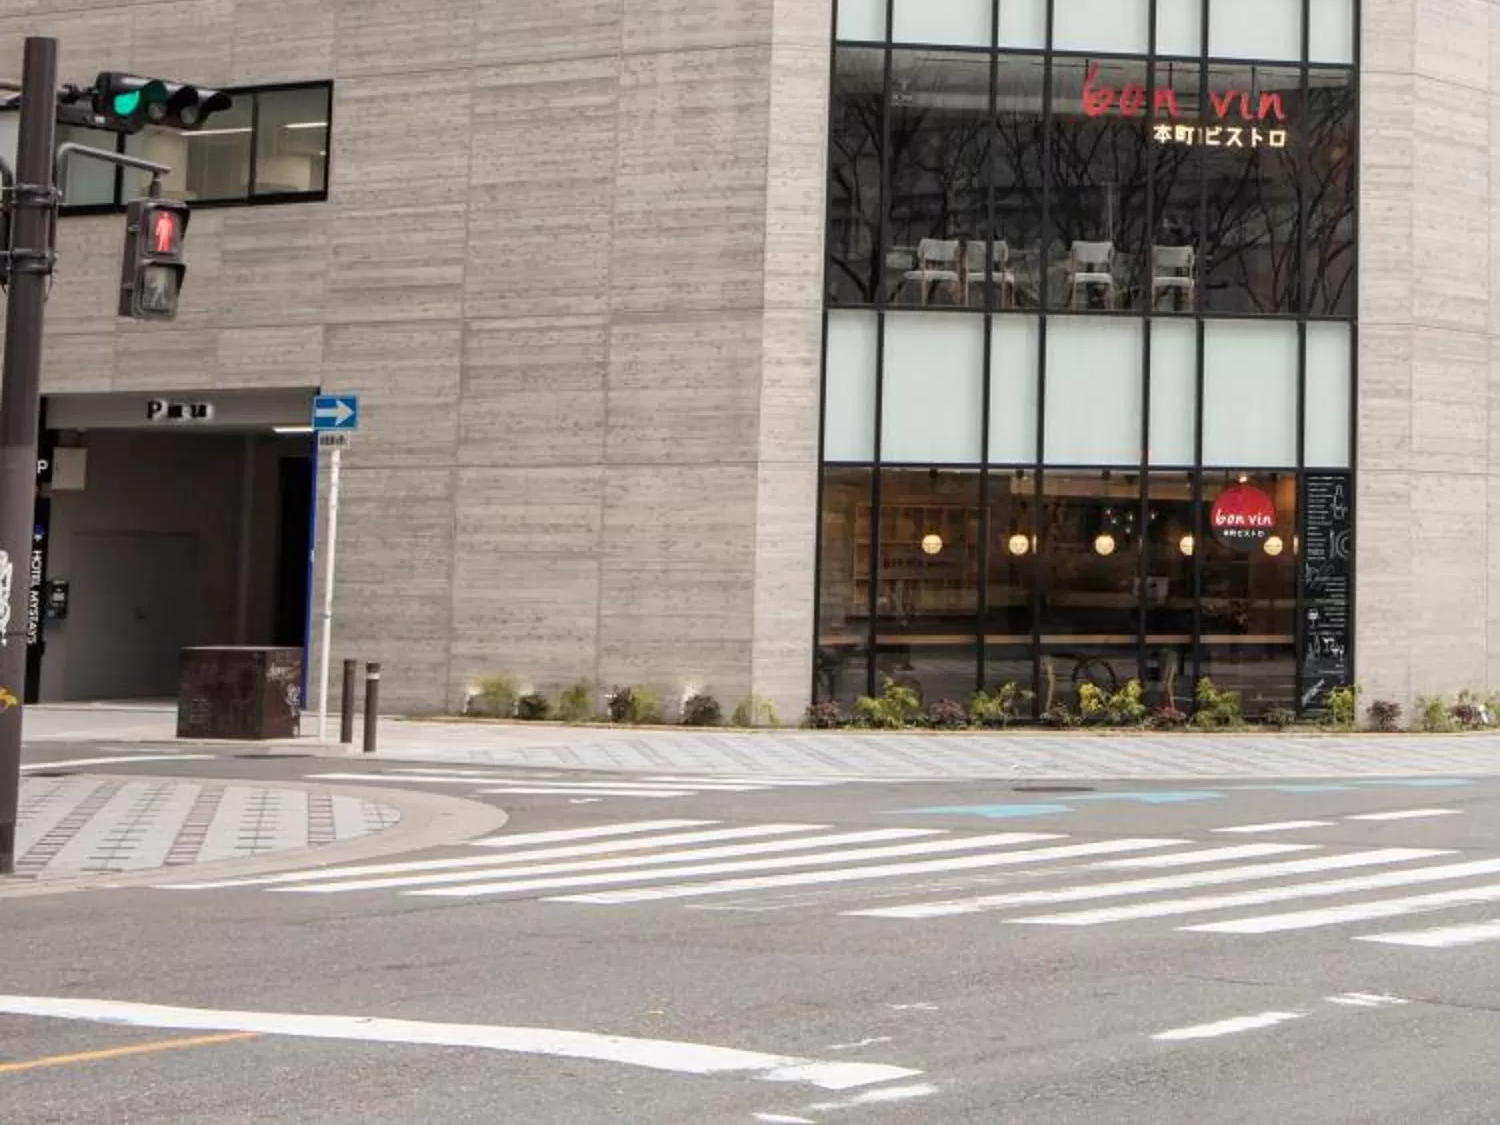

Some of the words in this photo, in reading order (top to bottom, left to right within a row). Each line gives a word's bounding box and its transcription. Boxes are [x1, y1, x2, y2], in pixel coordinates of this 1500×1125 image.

[1081, 59, 1179, 119] bon
[1207, 90, 1287, 121] vin
[37, 459, 48, 474] P
[1215, 509, 1245, 526] bon
[1249, 512, 1272, 526] vin
